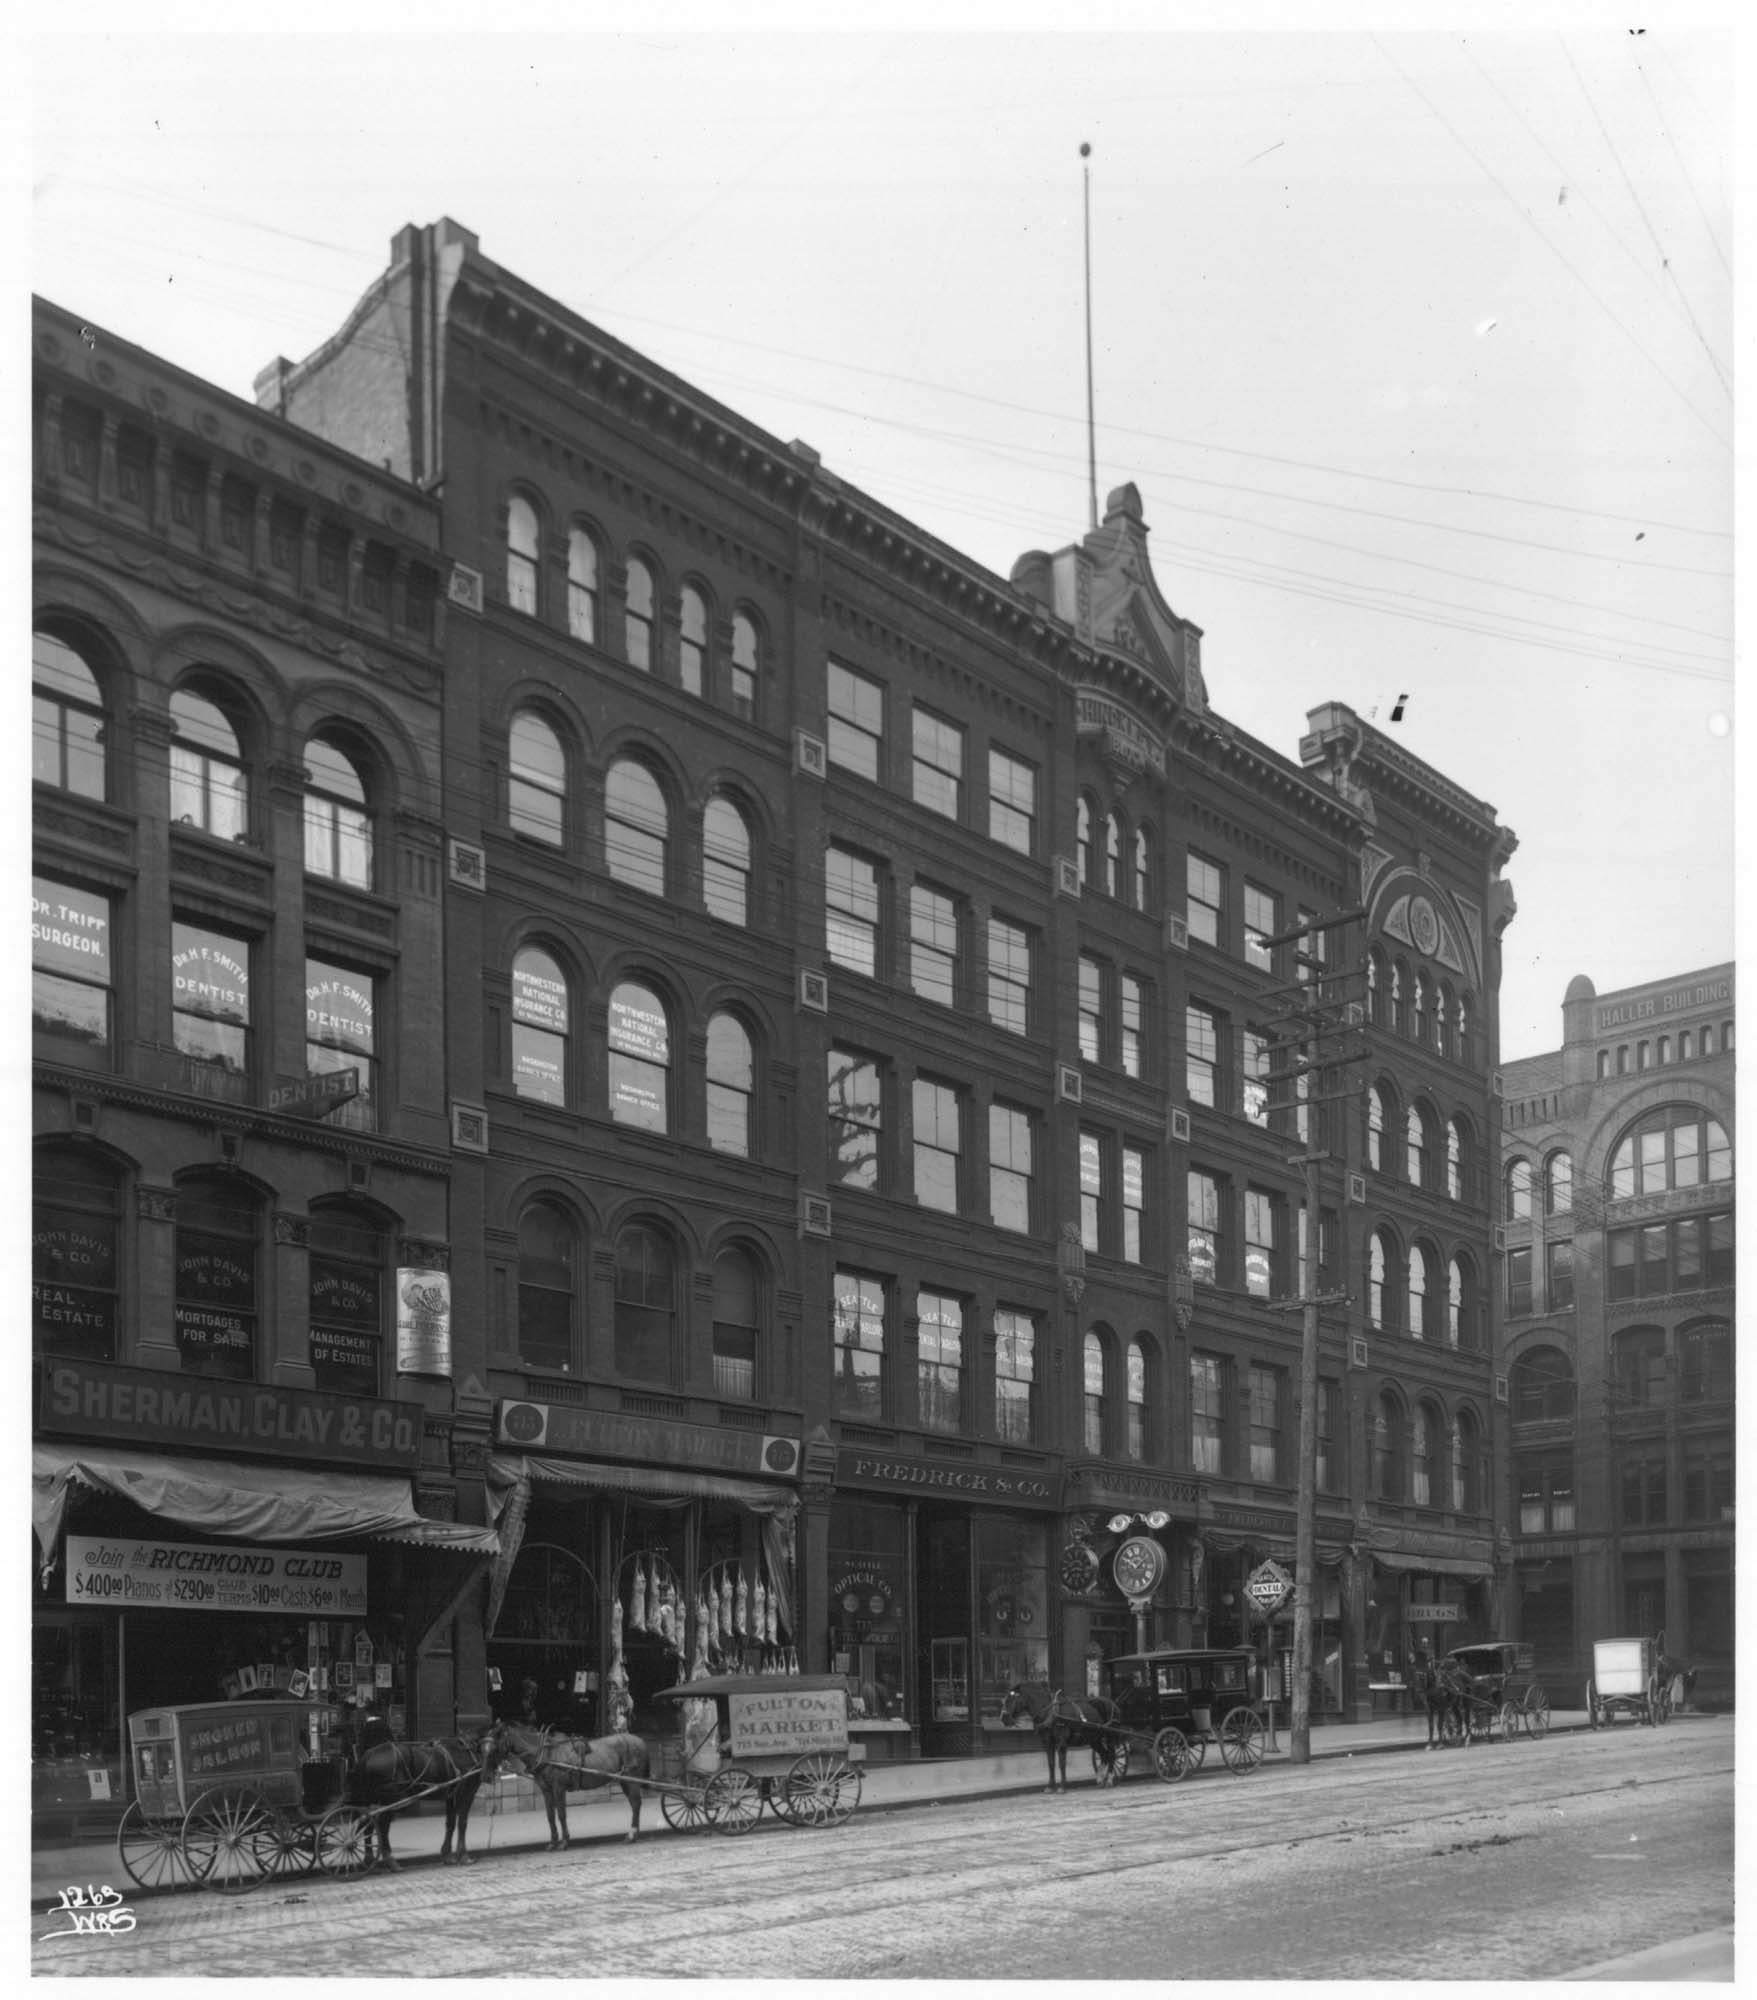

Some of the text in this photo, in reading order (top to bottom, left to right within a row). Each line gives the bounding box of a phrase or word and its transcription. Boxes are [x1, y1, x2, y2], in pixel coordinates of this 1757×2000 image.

[32, 896, 106, 931] DR. TRIPP
[32, 923, 104, 957] SURGEON.
[213, 951, 248, 984] SMITH
[175, 975, 247, 1006] DENTIST
[343, 985, 372, 1017] SMITH
[1602, 982, 1729, 1028] HALLER BUILDING
[307, 1008, 372, 1038] DENTIST
[269, 1071, 353, 1108] DENTIST
[71, 1233, 110, 1257] DAVIS
[180, 1256, 249, 1284] JOHN DAVIS
[313, 1279, 374, 1304] JOHN DAVIS
[840, 1295, 879, 1313] SEATTLE
[42, 1305, 104, 1328] ESTATE
[175, 1309, 241, 1330] MORTGAGES
[183, 1329, 207, 1342] FOR
[310, 1329, 372, 1349] MANAGEMENT
[314, 1348, 329, 1360] OF
[54, 1369, 249, 1439] SHERMAN,
[254, 1394, 335, 1443] CLAY
[340, 1405, 369, 1447] &
[855, 1460, 1049, 1497] FREDRICK & CO.
[85, 1545, 125, 1567] Join
[150, 1548, 275, 1576] RICHMOND
[285, 1558, 344, 1579] CLUB
[124, 1574, 162, 1599] Pianos
[834, 1572, 875, 1594] OPTICAL
[1254, 1584, 1281, 1594] DENTAL
[1407, 1607, 1457, 1618] DRUGS
[745, 1697, 827, 1716] FULTON
[192, 1739, 261, 1772] SALMON
